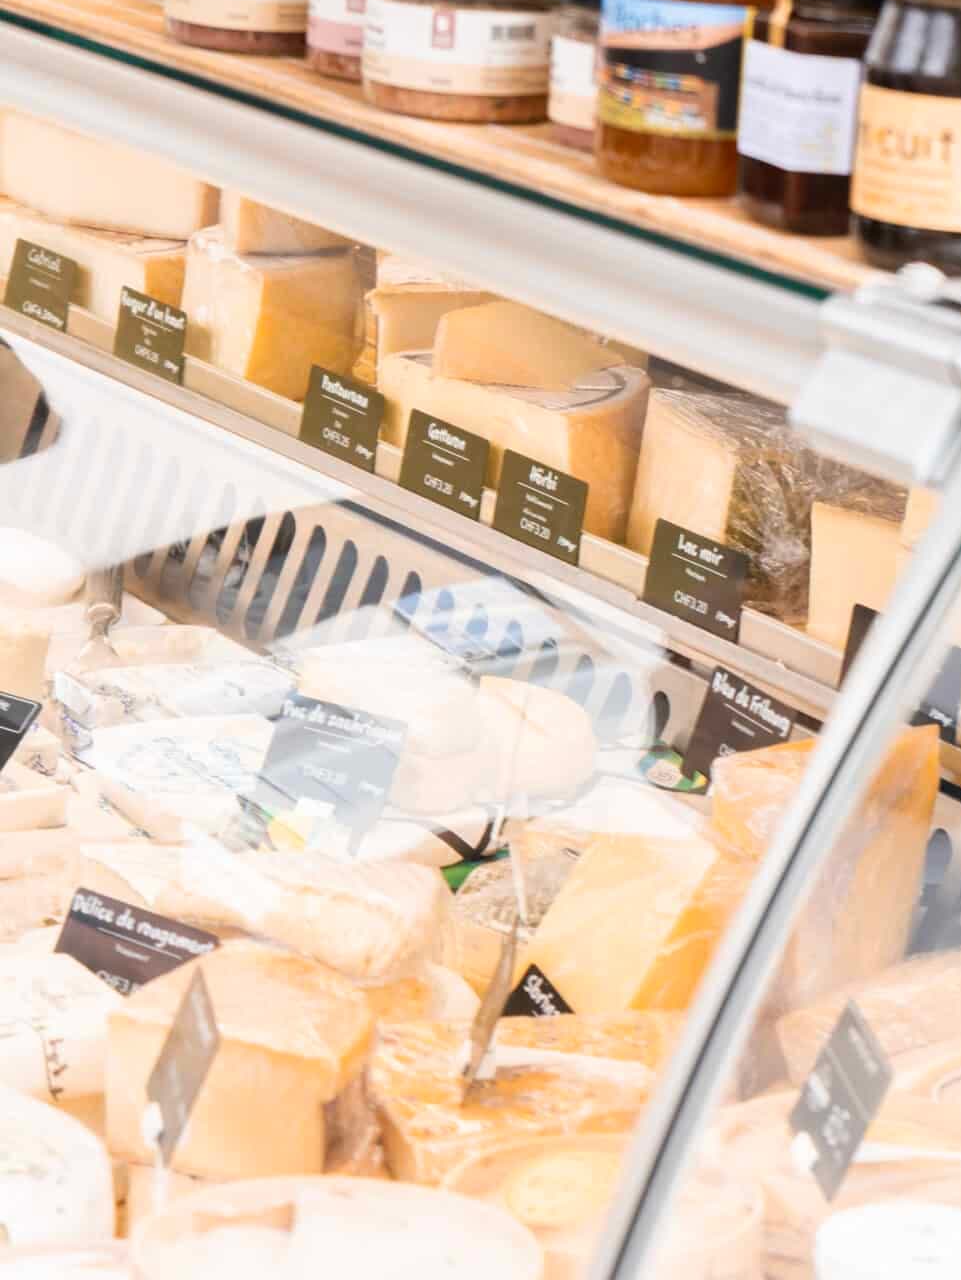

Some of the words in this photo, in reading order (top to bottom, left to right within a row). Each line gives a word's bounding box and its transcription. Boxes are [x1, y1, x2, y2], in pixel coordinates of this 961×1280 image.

[678, 534, 699, 557] Lac
[735, 685, 750, 708] de
[750, 695, 791, 737] Fribourg
[72, 893, 115, 924] Délice
[115, 908, 137, 931] de
